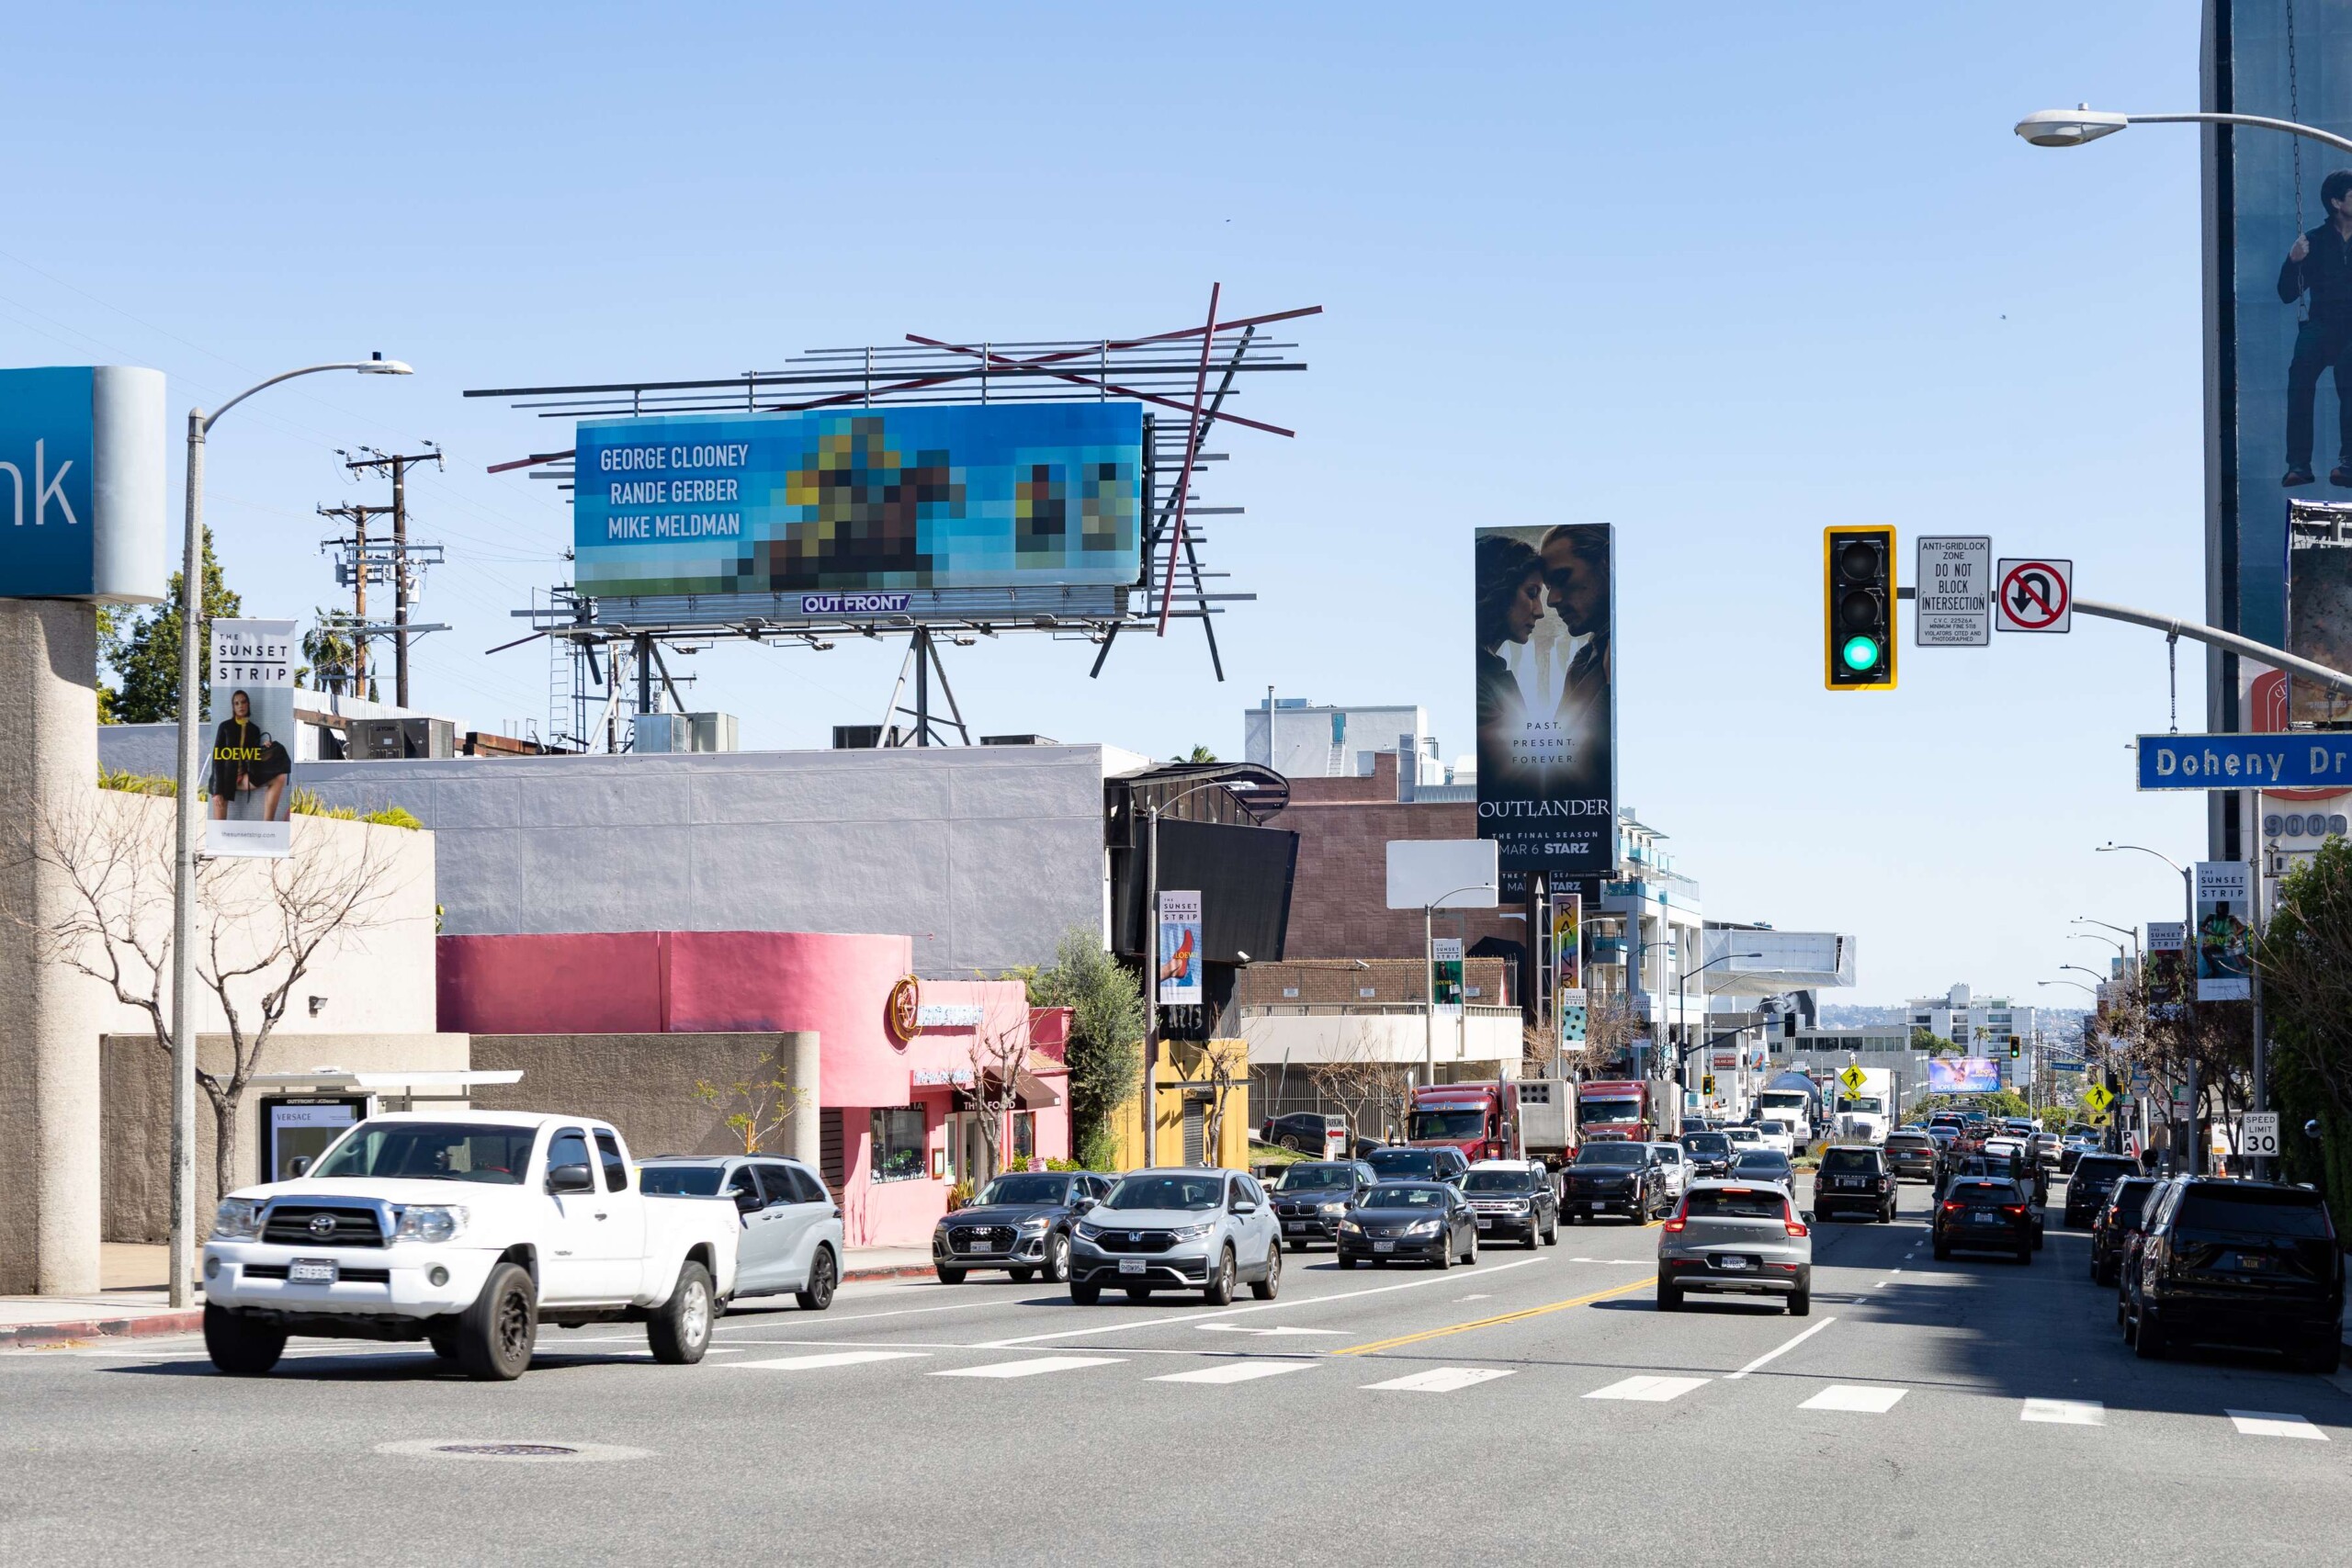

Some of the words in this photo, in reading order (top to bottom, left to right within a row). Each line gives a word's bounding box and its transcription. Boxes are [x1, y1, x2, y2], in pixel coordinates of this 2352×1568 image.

[600, 446, 667, 471] GEORGE
[671, 444, 750, 468] CLOONEY
[610, 480, 667, 504] RANDE
[672, 479, 738, 502] GERBER
[608, 515, 650, 539] MIKE
[655, 513, 740, 537] MELDMAN
[1922, 542, 1985, 550] ANTI-GRIDLOCK
[1942, 551, 1965, 560] ZONE
[1935, 563, 1949, 577] DO
[1954, 563, 1973, 577] NOT
[1939, 580, 1968, 593] BLOCK
[805, 595, 907, 612] OUTFRONT
[1922, 596, 1984, 611] INTERSECTION
[220, 645, 287, 657] SUNSET
[220, 668, 287, 681] STRIP
[1526, 722, 1562, 730] PAST.
[1513, 739, 1576, 748] PRESENT.
[213, 747, 262, 761] LOEWE
[1512, 755, 1577, 764] FOREVER.
[2156, 749, 2285, 782] Doheny
[2310, 746, 2346, 775] Dr
[1478, 799, 1611, 818] OUTLANDER
[2264, 814, 2348, 837] 9000
[221, 831, 276, 840] thesunsetstrip.com
[1498, 843, 1527, 855] MAR
[1531, 843, 1539, 855] 6
[1544, 842, 1589, 854] STARZ
[1508, 882, 1527, 892] MA
[1550, 882, 1581, 891] TARZ
[2201, 889, 2244, 897] STRIP
[988, 1100, 1016, 1110] FOD
[1327, 1118, 1344, 1128] PARKING
[2245, 1115, 2276, 1124] SPEED
[2247, 1135, 2276, 1152] 30
